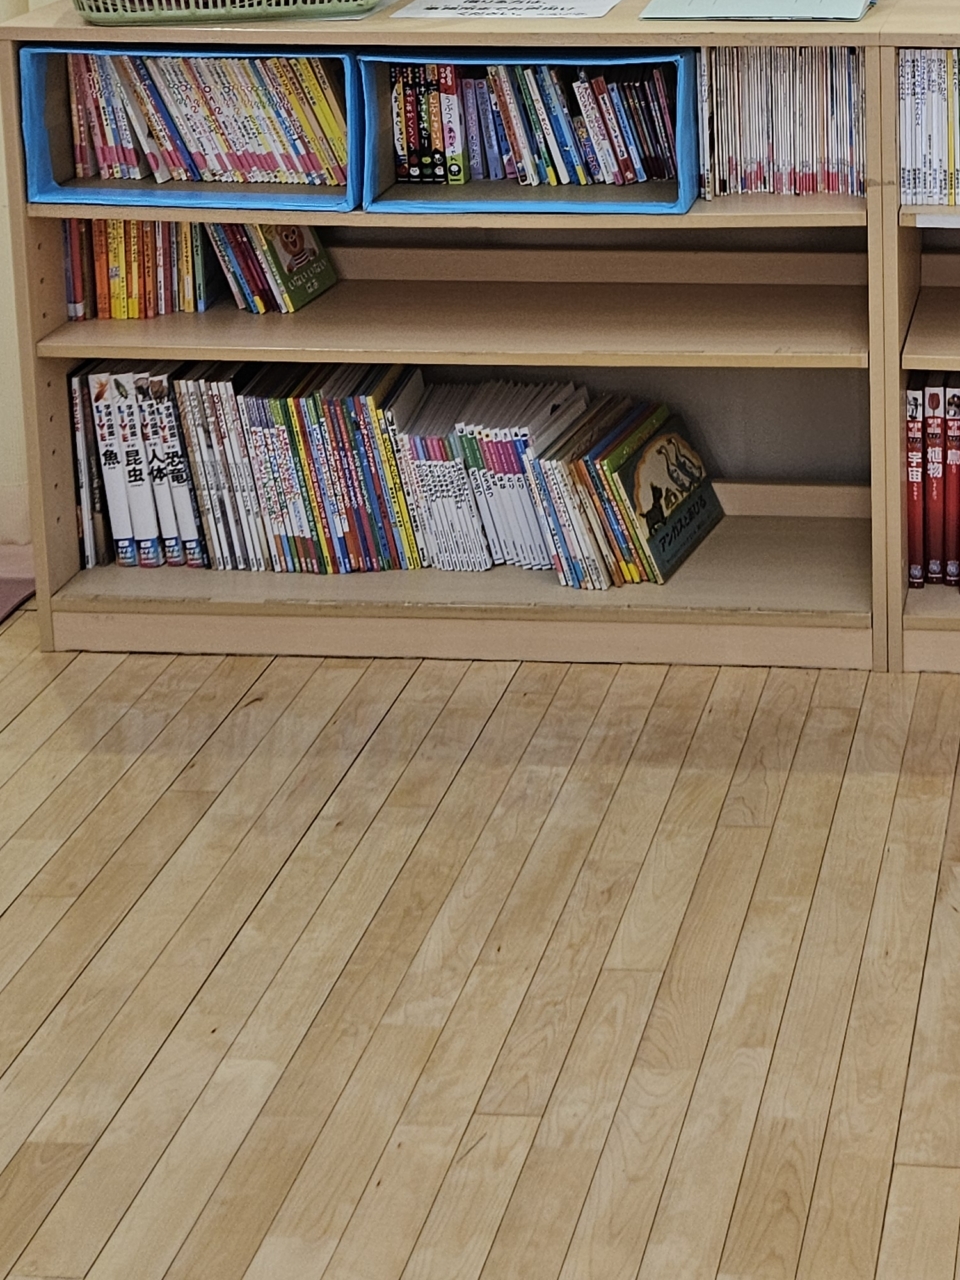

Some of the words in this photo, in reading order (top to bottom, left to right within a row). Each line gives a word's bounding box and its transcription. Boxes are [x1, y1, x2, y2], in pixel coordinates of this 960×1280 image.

[102, 448, 121, 467] 魚
[125, 449, 145, 484] 昆虫
[147, 448, 168, 483] 人体
[164, 450, 188, 484] 恐竜
[908, 451, 922, 482] 宇宙
[927, 446, 943, 478] 植物
[507, 476, 515, 490] とり
[516, 476, 525, 490] とり
